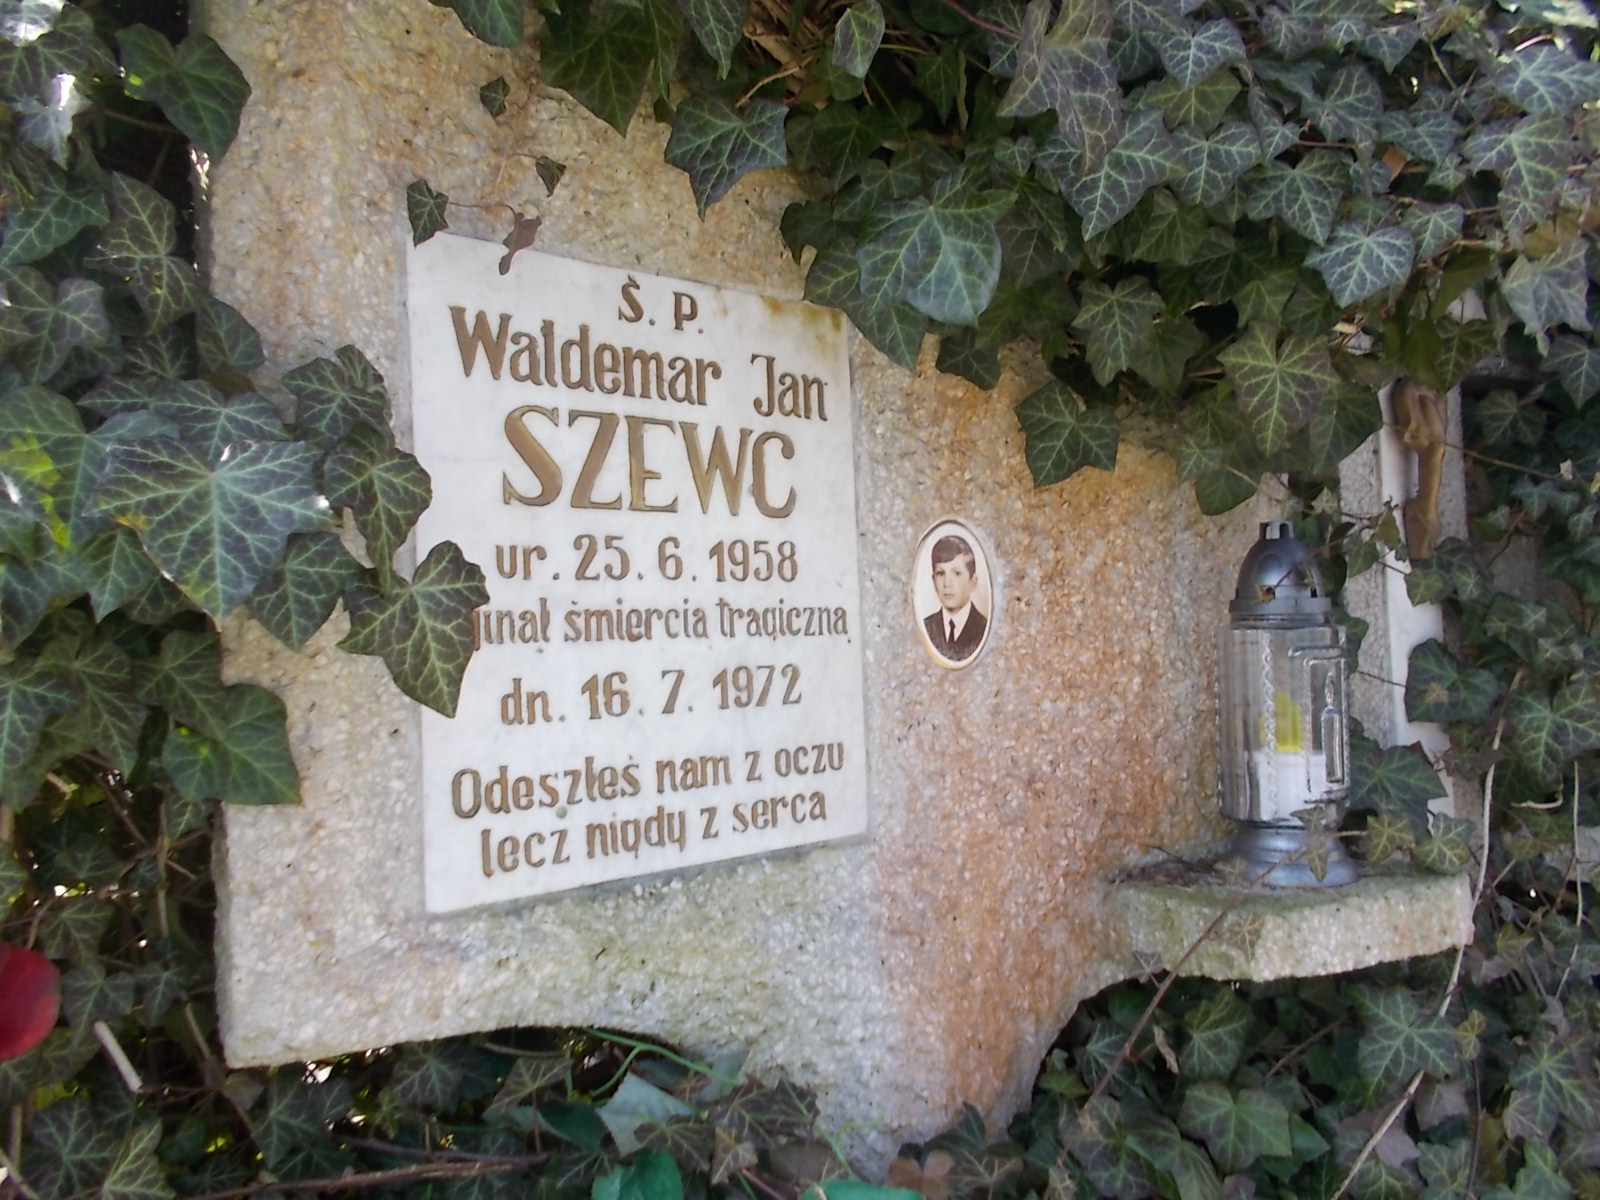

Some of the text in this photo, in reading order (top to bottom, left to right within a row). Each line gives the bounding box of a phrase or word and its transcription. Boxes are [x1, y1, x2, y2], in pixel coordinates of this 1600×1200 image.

[448, 304, 829, 422] Waldemar Jan
[502, 404, 797, 519] SZEWC
[500, 677, 567, 726] dn.
[451, 741, 845, 819] Odeszłeś nam z oczu
[480, 790, 827, 879] lecz nigdy z serca
